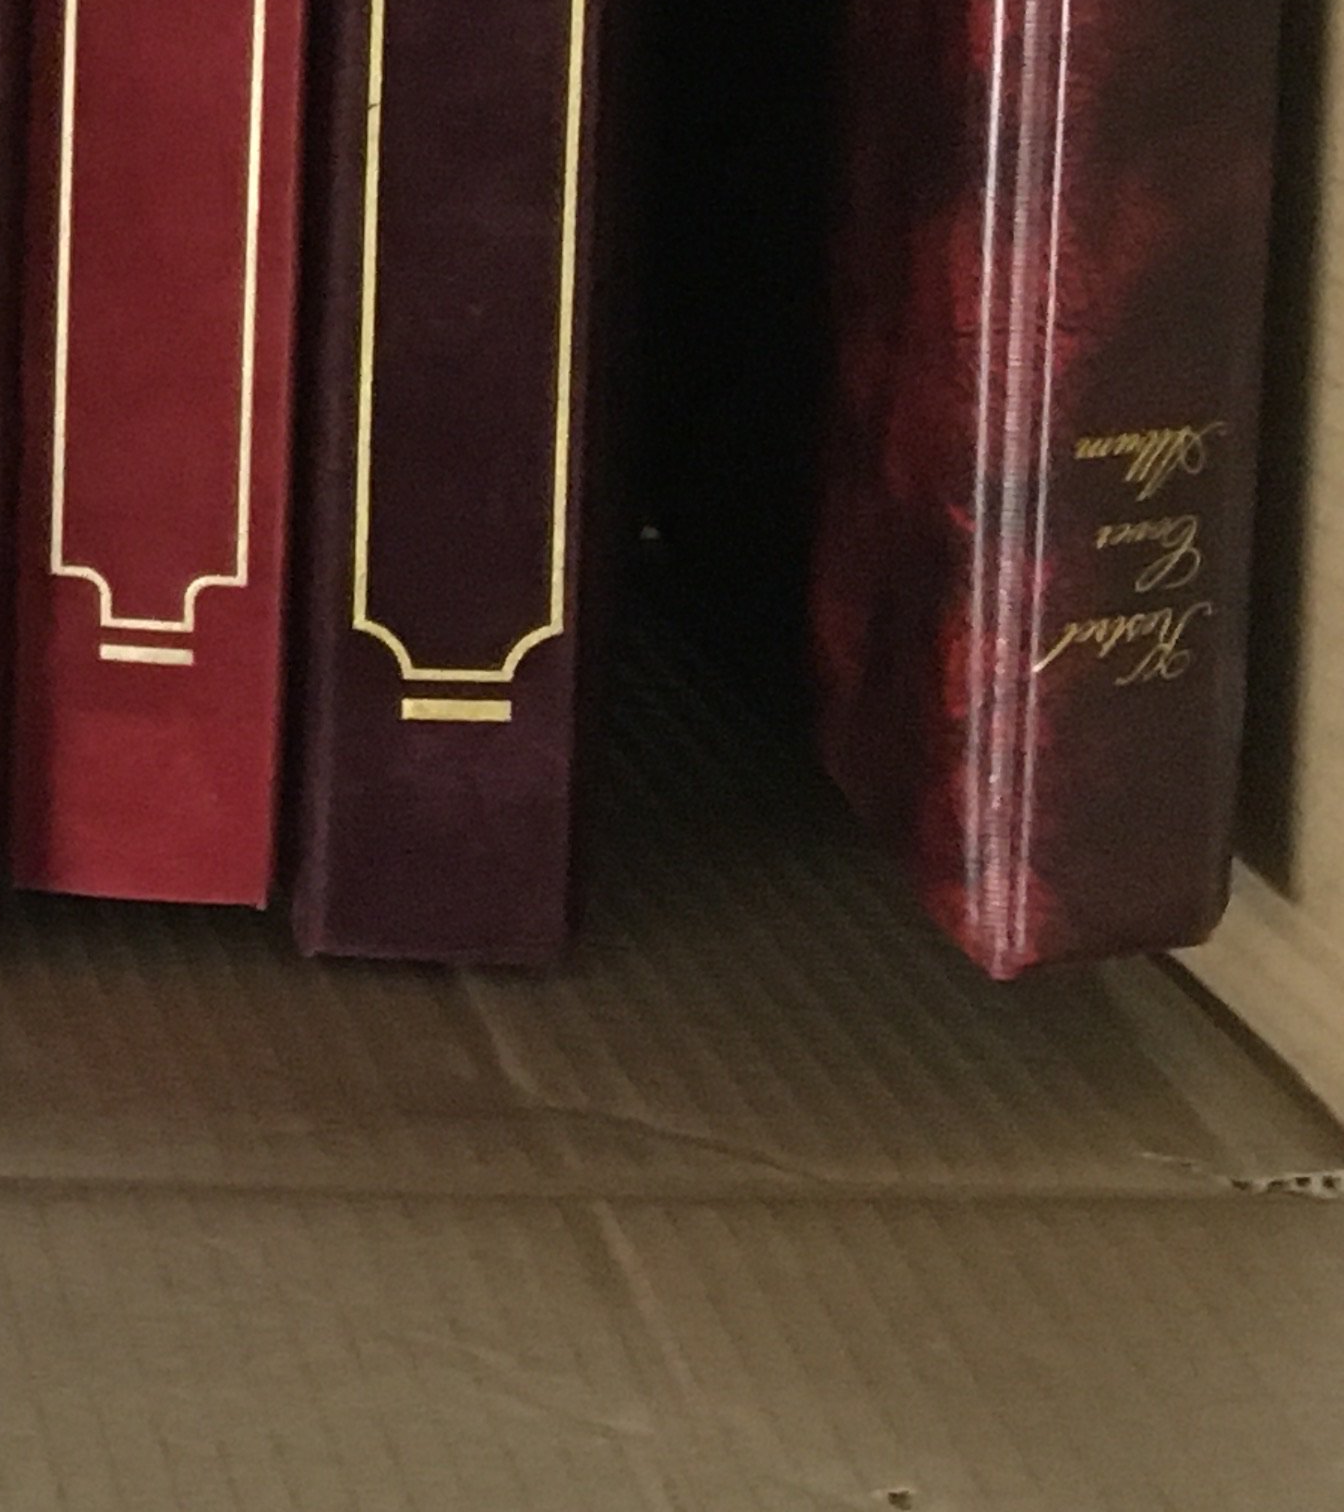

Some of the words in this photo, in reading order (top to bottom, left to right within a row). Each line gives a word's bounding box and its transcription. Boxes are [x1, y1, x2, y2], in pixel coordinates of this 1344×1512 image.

[1074, 420, 1228, 502] Album
[1096, 515, 1202, 593] Cover
[1032, 601, 1212, 686] Kestrel
